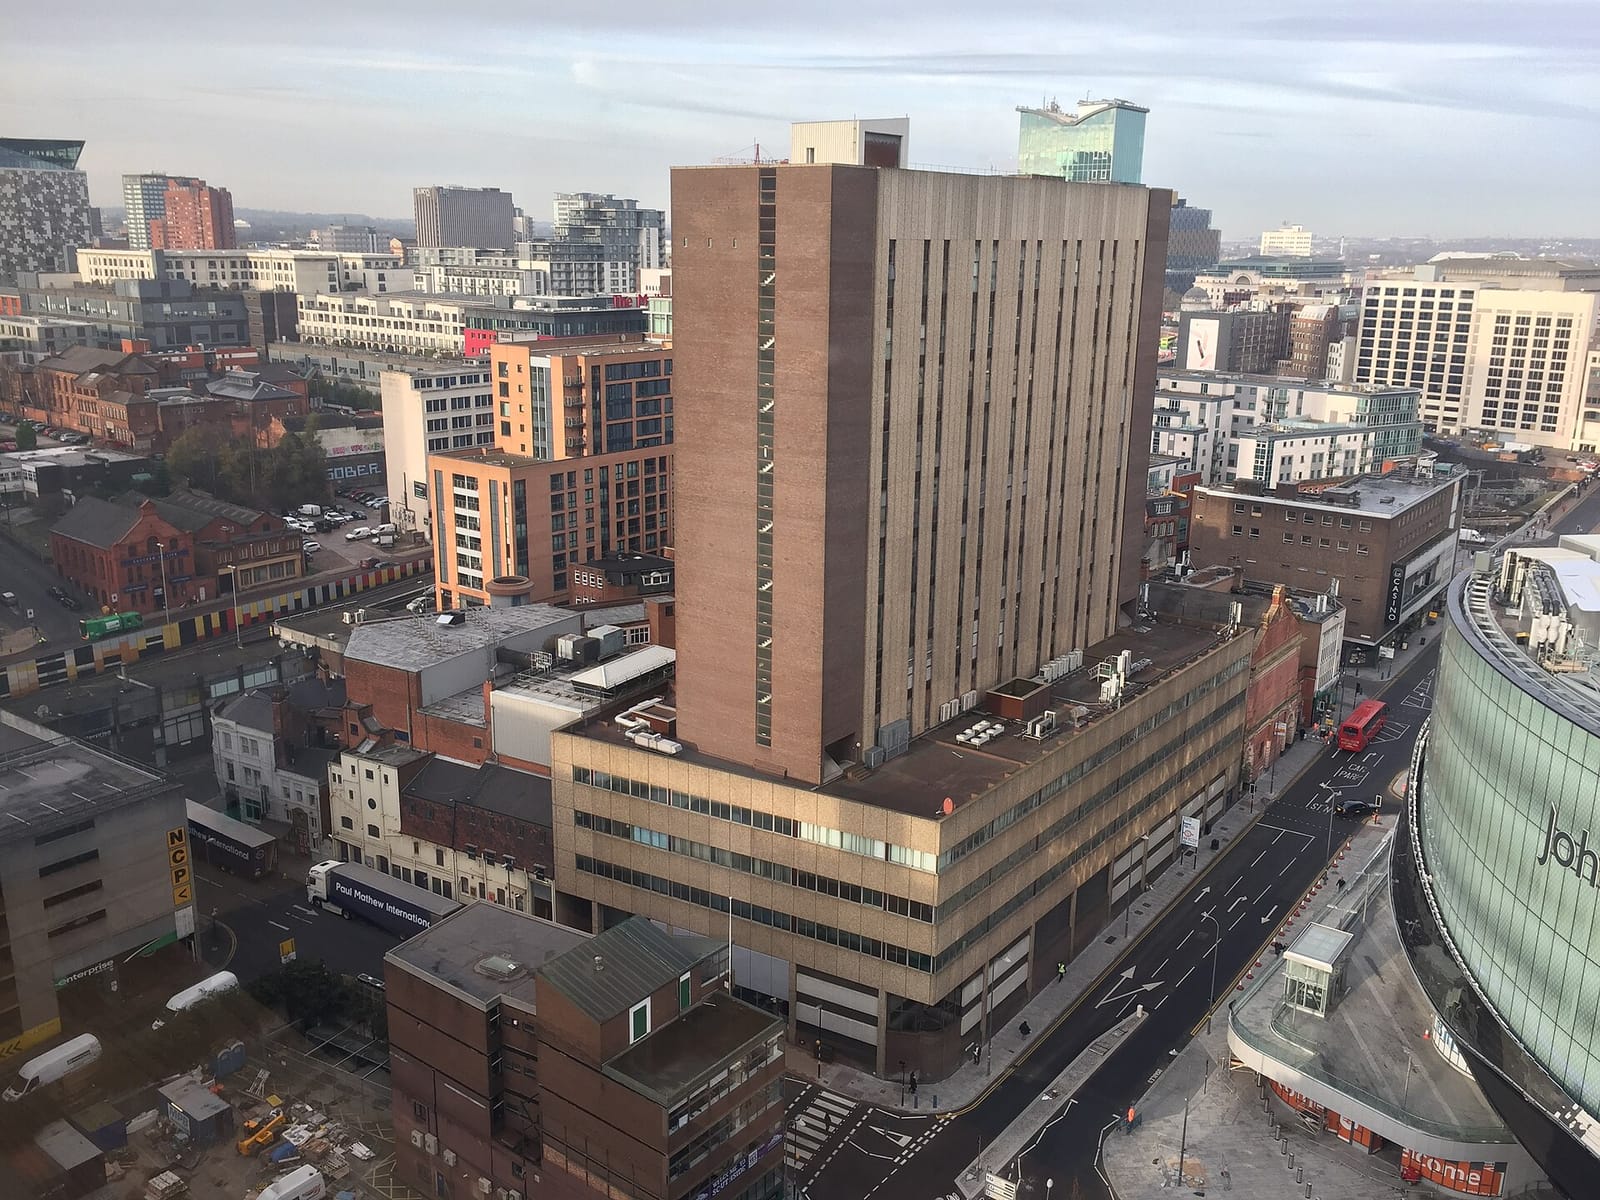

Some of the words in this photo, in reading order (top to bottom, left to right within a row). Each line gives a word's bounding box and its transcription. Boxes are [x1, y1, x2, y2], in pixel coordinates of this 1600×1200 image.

[1388, 578, 1400, 621] CASINO
[169, 829, 187, 884] NCP
[335, 882, 352, 897] Paul
[354, 889, 385, 910] Mathew
[55, 960, 114, 986] enterprise
